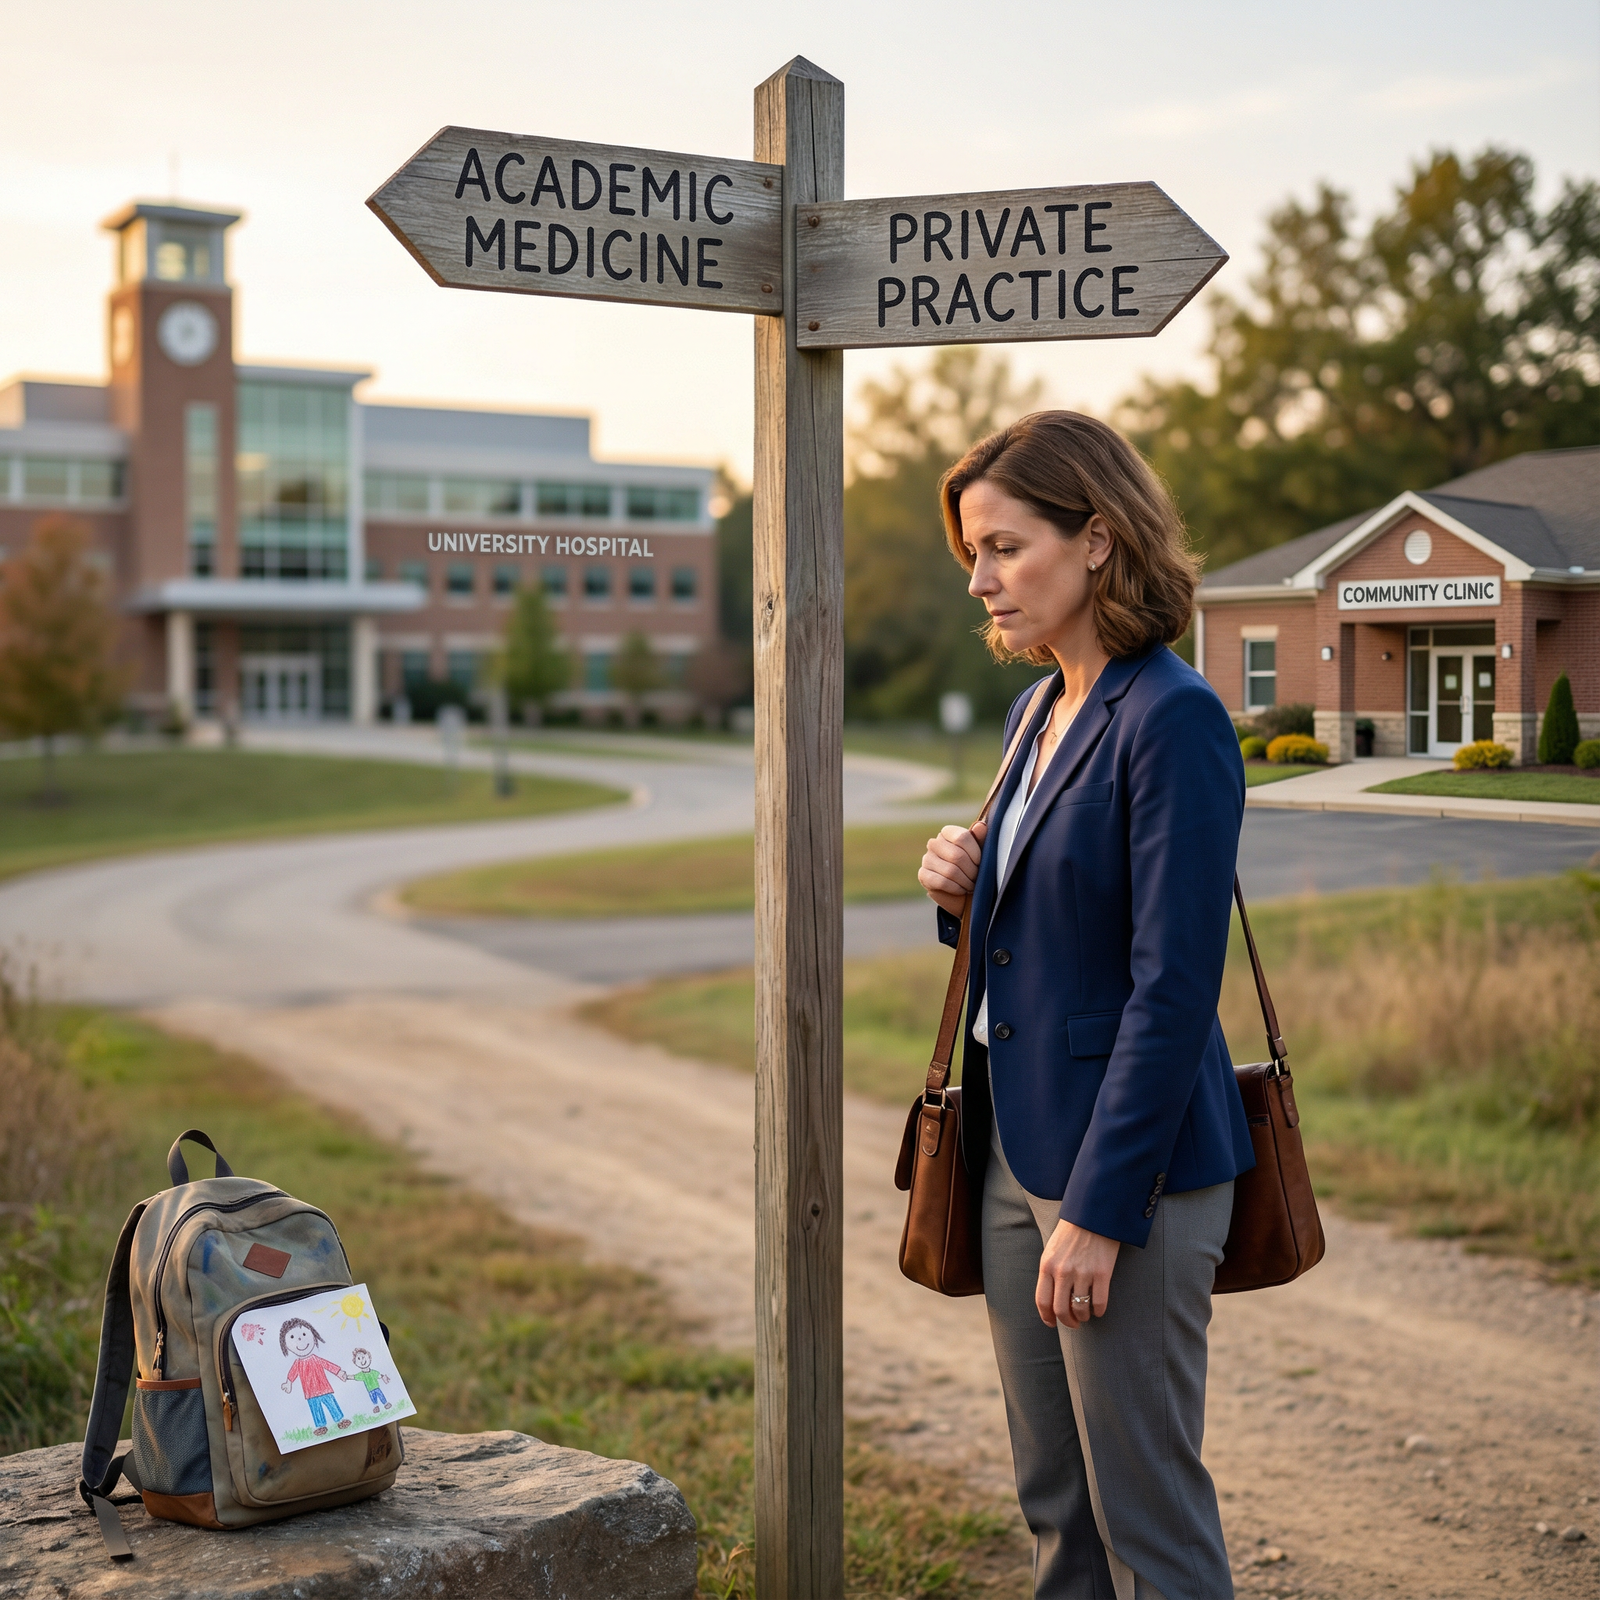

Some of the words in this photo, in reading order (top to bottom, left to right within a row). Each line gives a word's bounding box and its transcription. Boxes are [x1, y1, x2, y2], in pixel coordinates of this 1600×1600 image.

[454, 147, 734, 225] ACADEMIC
[464, 215, 724, 289] MEDICINE
[889, 201, 1113, 264] PRIVATE
[877, 265, 1140, 328] PRACTICE
[428, 532, 550, 555] UNIVERSITY
[556, 536, 654, 558] HOSPITAL
[1343, 583, 1439, 603] COMMUNITY
[1443, 582, 1495, 600] CLINIC
